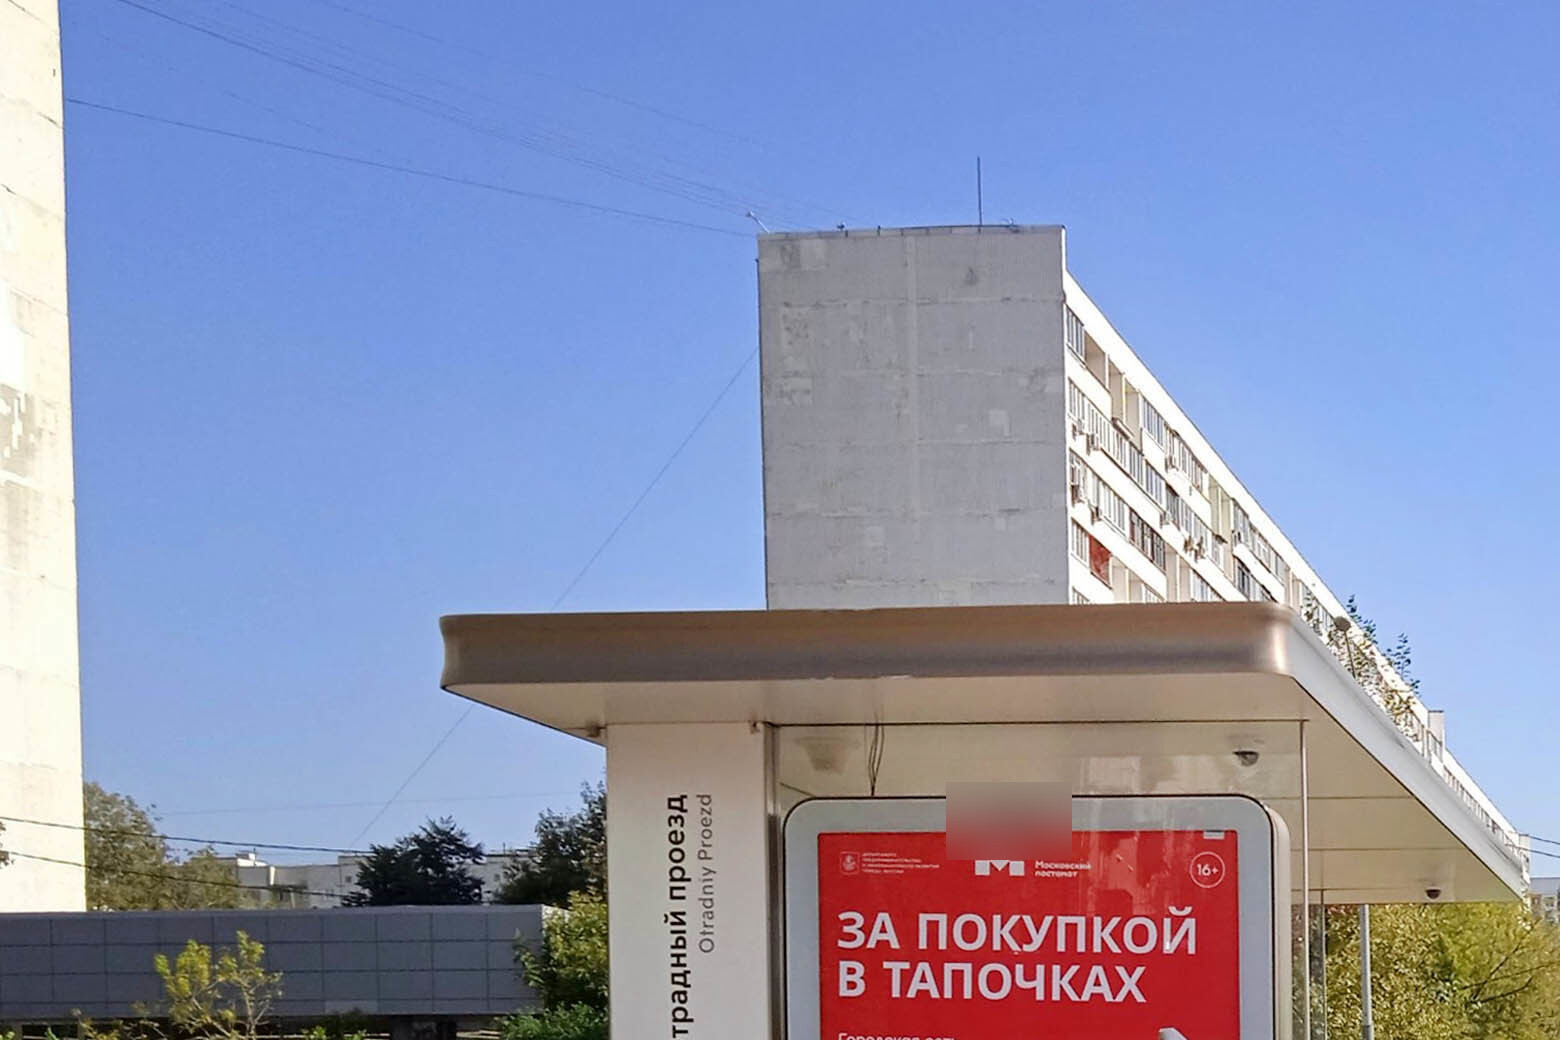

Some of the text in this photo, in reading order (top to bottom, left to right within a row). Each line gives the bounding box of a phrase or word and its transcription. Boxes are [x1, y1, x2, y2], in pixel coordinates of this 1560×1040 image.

[667, 794, 692, 900] проезд
[1196, 863, 1219, 877] 16+
[696, 794, 717, 953] Otradniy Proezd
[837, 906, 1196, 954] ЗА ПОКУПКОЙ
[838, 960, 1147, 1003] В ТАПОЧКАХ
